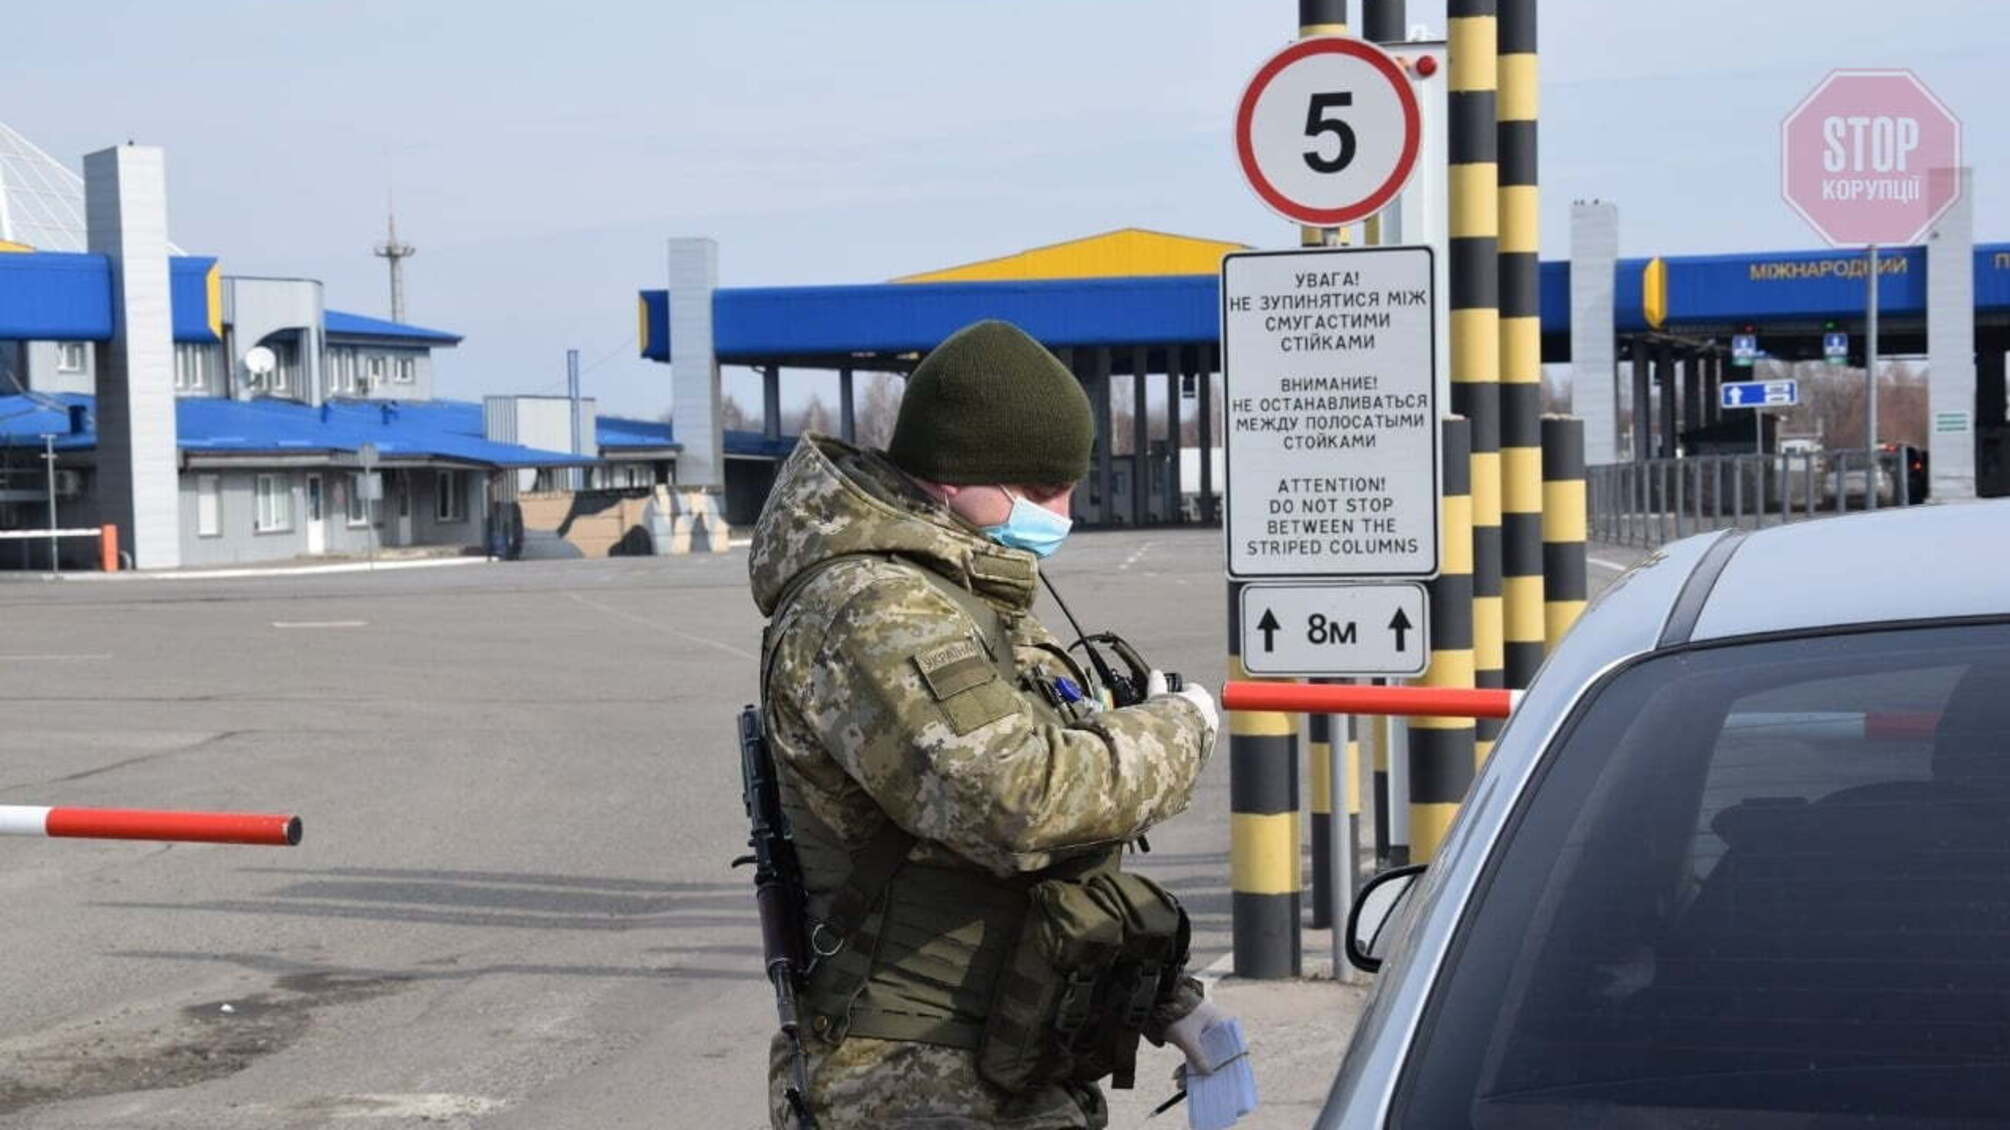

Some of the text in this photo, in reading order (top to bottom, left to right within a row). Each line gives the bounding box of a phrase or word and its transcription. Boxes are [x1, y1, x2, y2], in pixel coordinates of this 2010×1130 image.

[1303, 91, 1357, 174] 5
[1295, 271, 1360, 289] УВАГА!
[1230, 290, 1426, 312] НЕ ЗУПИНЯТИСЯ МІЖ
[1265, 313, 1391, 332] СМУГАСТИМИ
[1281, 332, 1375, 352] СТІЙКАМИ
[1281, 376, 1378, 393] ВНИМАНИЕ!
[1233, 394, 1427, 413] НЕ ОСТАНАВЛИВАТЬСЯ
[1237, 414, 1424, 432] МЕЖДУ ПОЛОСАТЫМИ
[1283, 433, 1376, 451] СТОЙКАМИ
[1278, 477, 1386, 494] ATTENTION!
[1270, 498, 1394, 514] DO NOT STOP
[1267, 518, 1396, 535] BETWEEN THE
[1247, 538, 1419, 556] STRIPED COLUMNS
